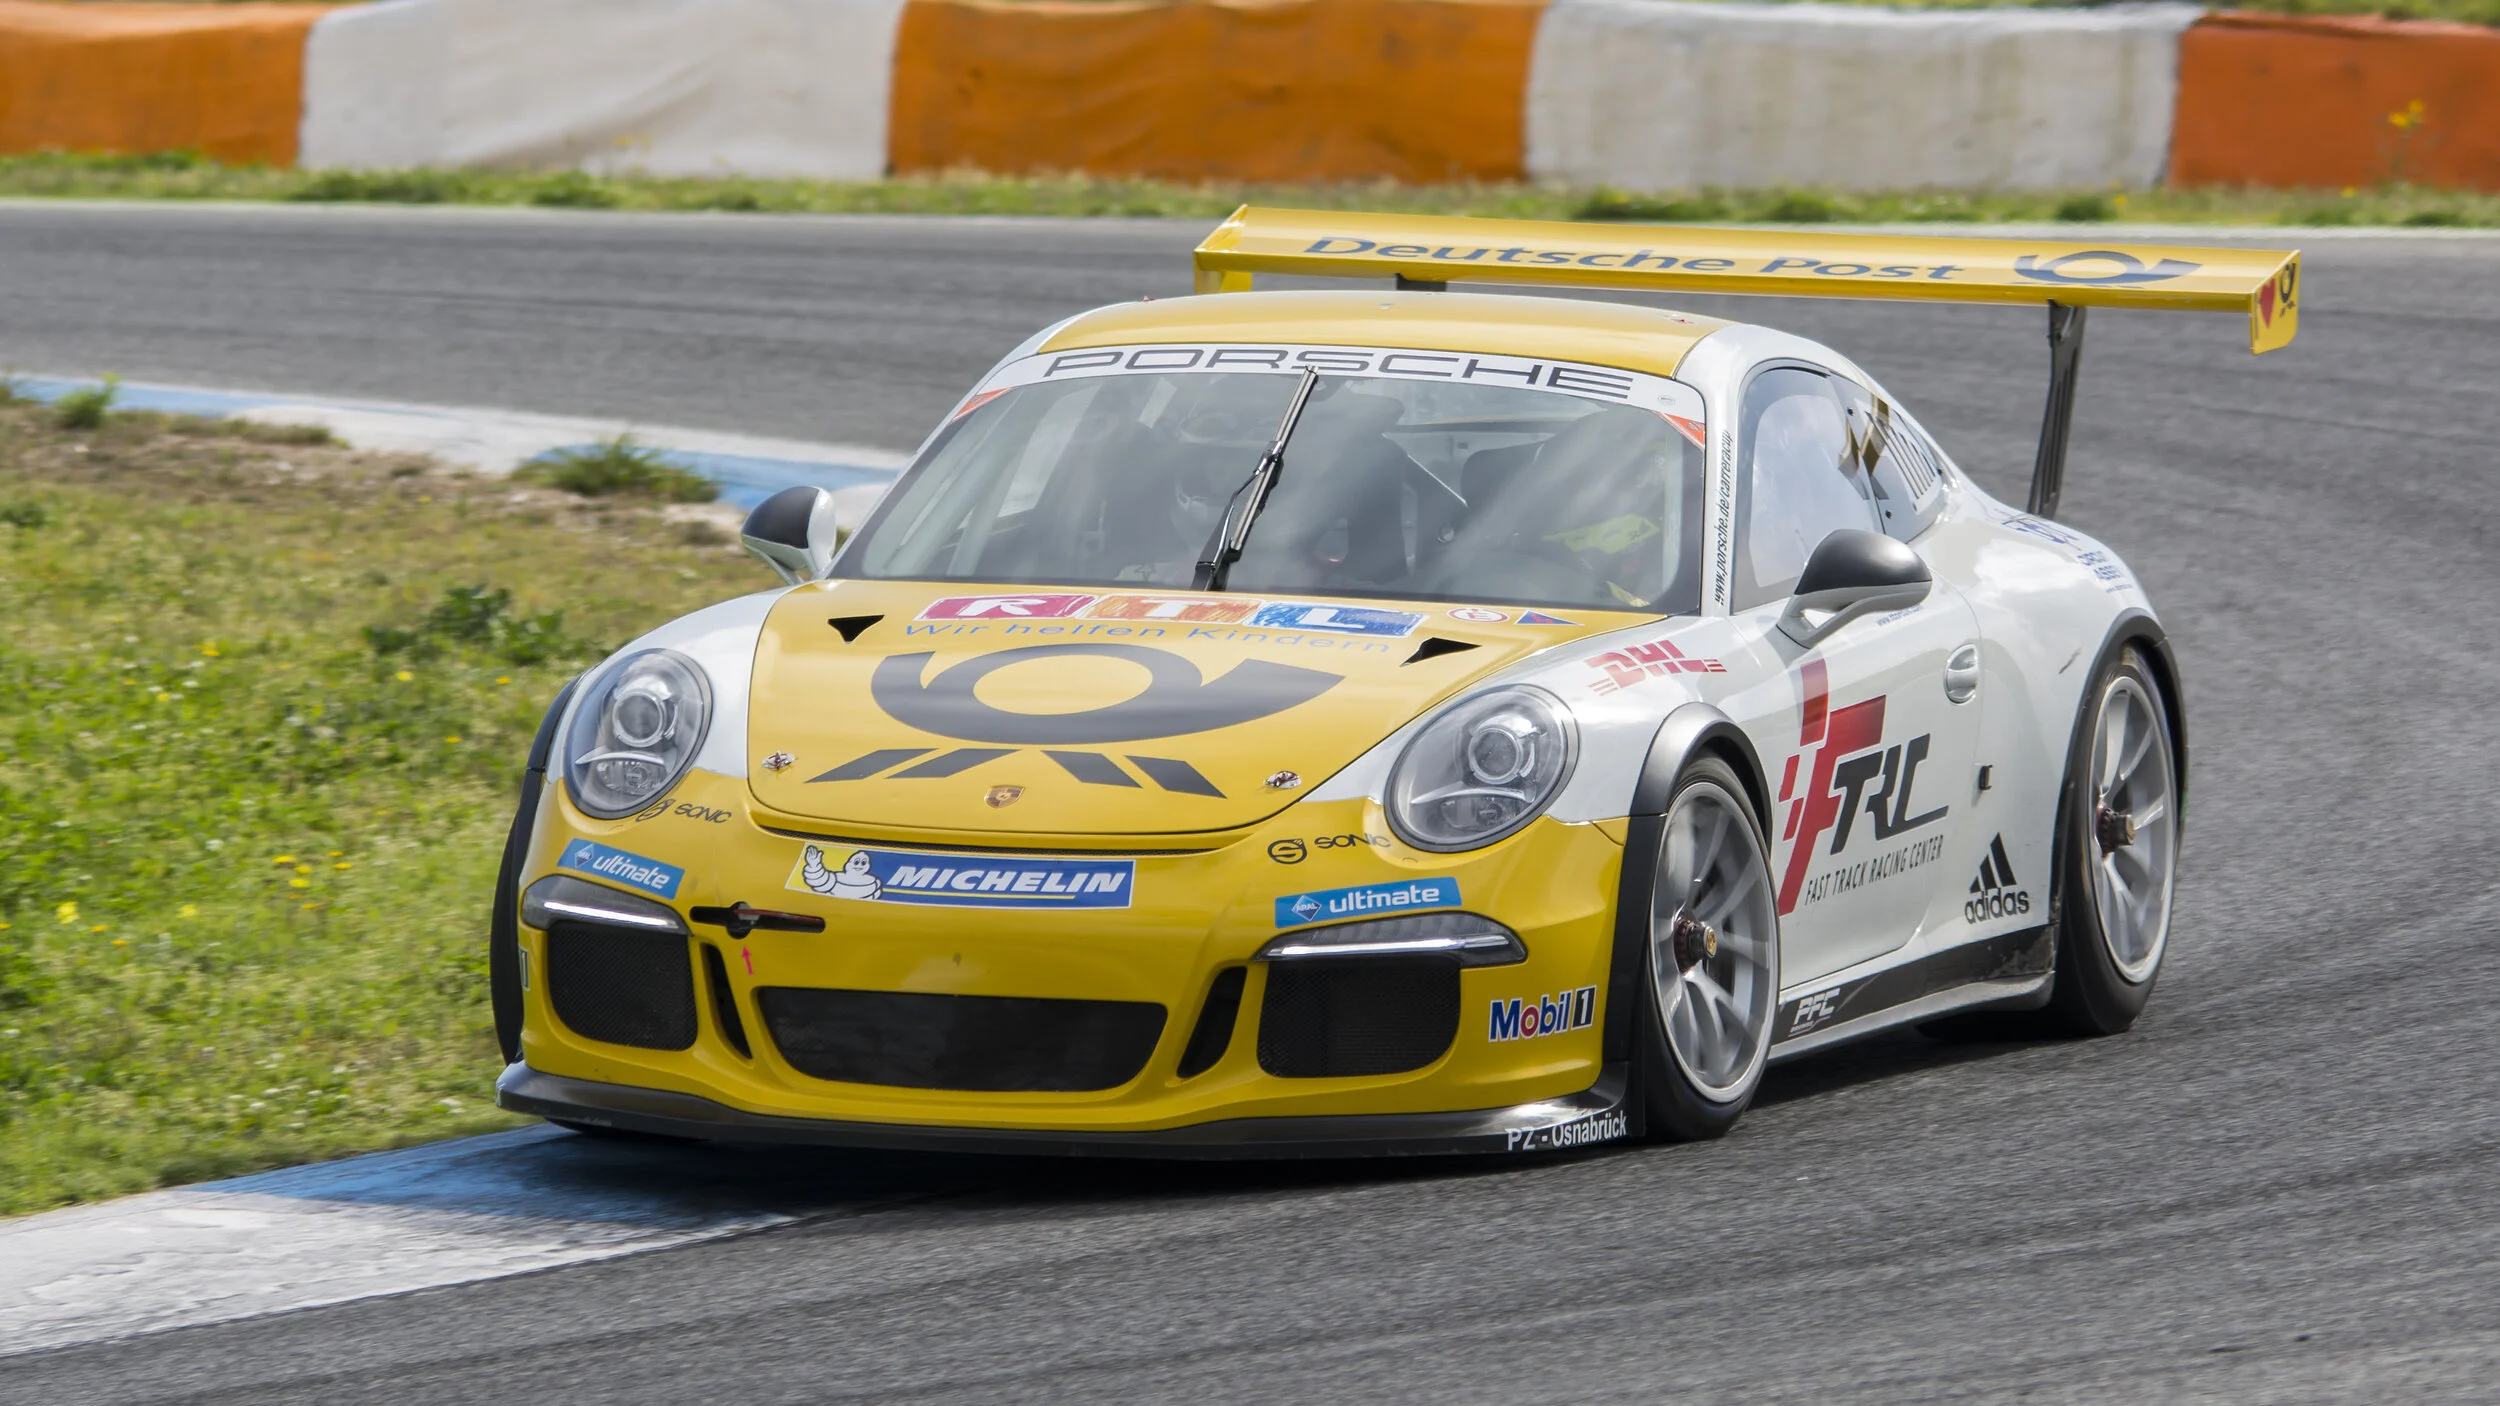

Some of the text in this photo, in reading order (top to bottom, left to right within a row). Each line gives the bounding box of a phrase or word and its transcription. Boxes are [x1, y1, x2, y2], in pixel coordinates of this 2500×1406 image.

[1304, 236, 1964, 280] Deutsche Post
[1042, 348, 1635, 400] PORSCHE
[905, 622, 1391, 653] Wir helfen Kindern
[1584, 639, 1712, 689] DHL
[674, 802, 733, 824] SONIC
[1313, 833, 1392, 849] SONIC
[592, 852, 670, 890] ultimate
[886, 865, 1127, 894] MICHELIN
[1804, 834, 1944, 906] FAST TRACK RACING CENTER
[1295, 884, 1440, 914] ARAL ultimate
[1964, 886, 2030, 924] adidas
[1489, 991, 1572, 1042] Mobil
[1793, 987, 1841, 1026] PFC
[1504, 1126, 1536, 1151] PZ
[1551, 1110, 1627, 1148] Osnabrück
